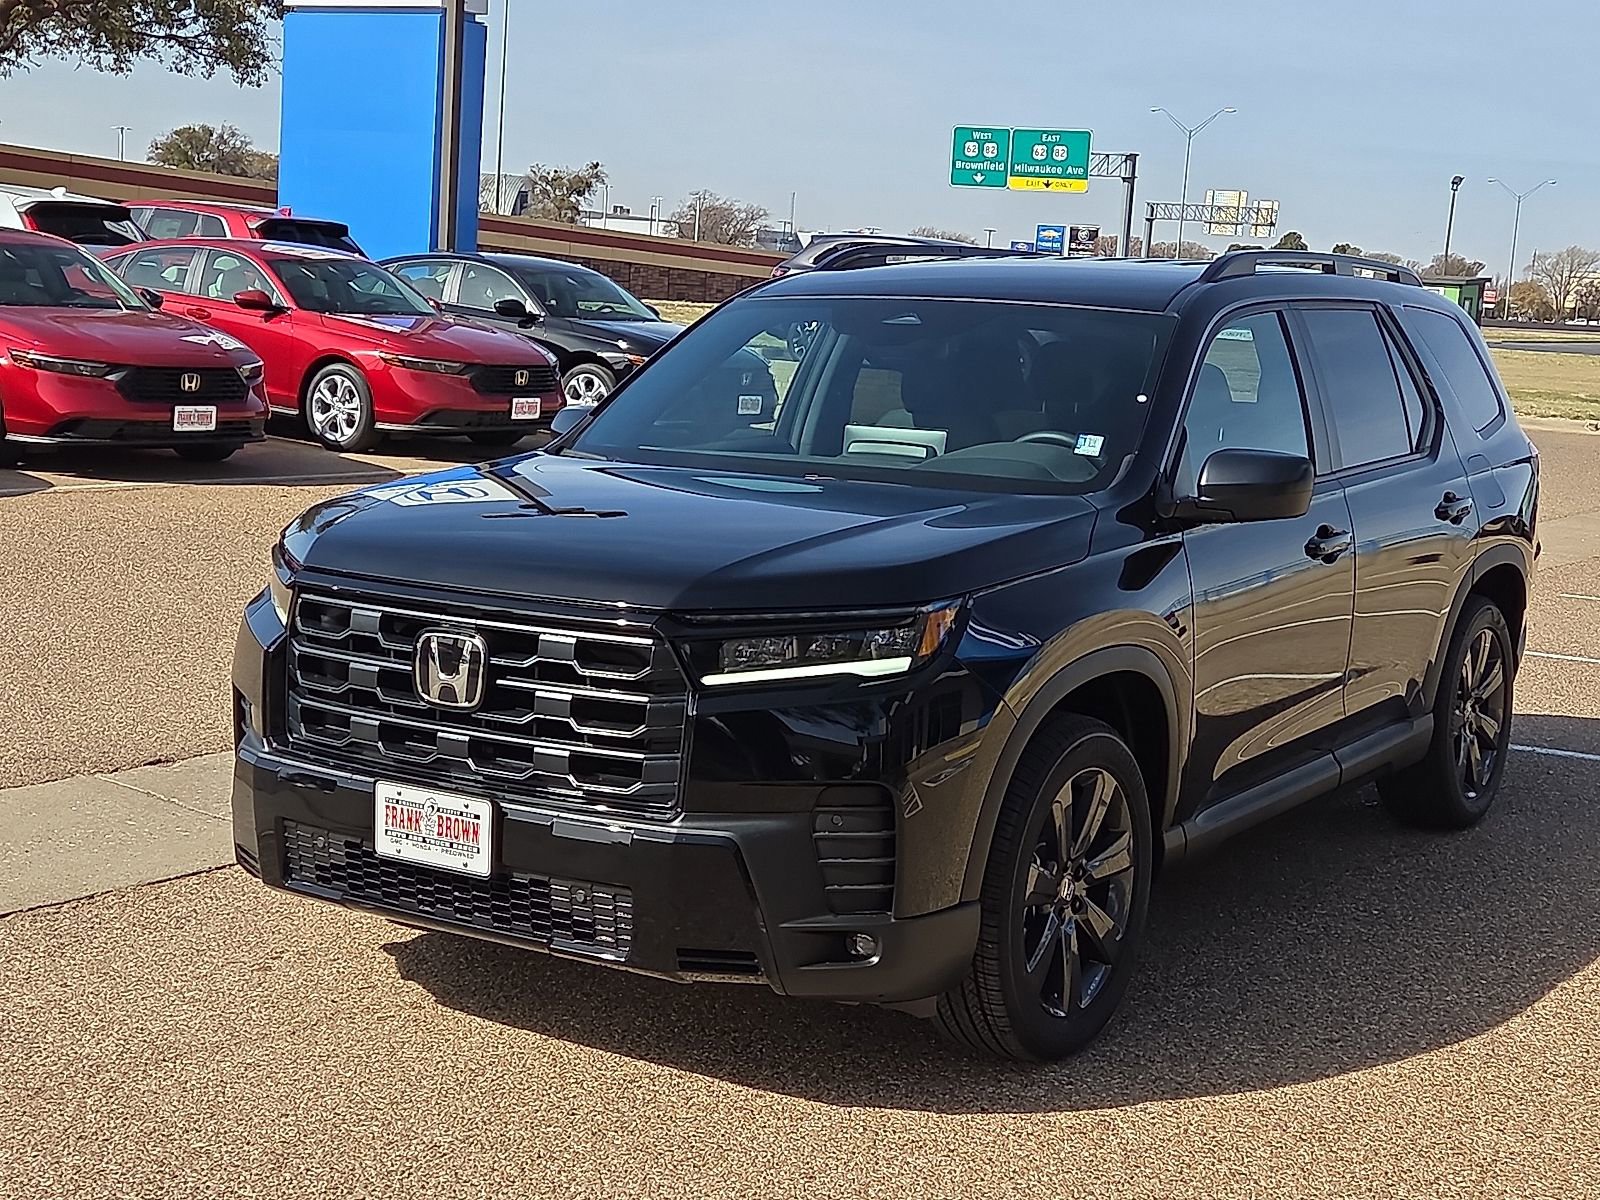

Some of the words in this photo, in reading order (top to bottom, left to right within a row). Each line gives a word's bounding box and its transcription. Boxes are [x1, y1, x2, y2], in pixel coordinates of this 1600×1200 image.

[972, 131, 992, 140] WEST
[1041, 133, 1061, 142] EAST
[966, 144, 977, 153] 62
[985, 145, 996, 154] 82
[1034, 148, 1046, 157] 62
[1054, 148, 1066, 158] 82
[955, 160, 1005, 171] Brownfield
[1013, 163, 1063, 174] Milwaukee
[1066, 165, 1085, 175] Ave
[384, 804, 423, 834] FRANK
[436, 814, 480, 845] BROWN
[390, 838, 403, 846] GMC
[412, 842, 432, 851] HONDA
